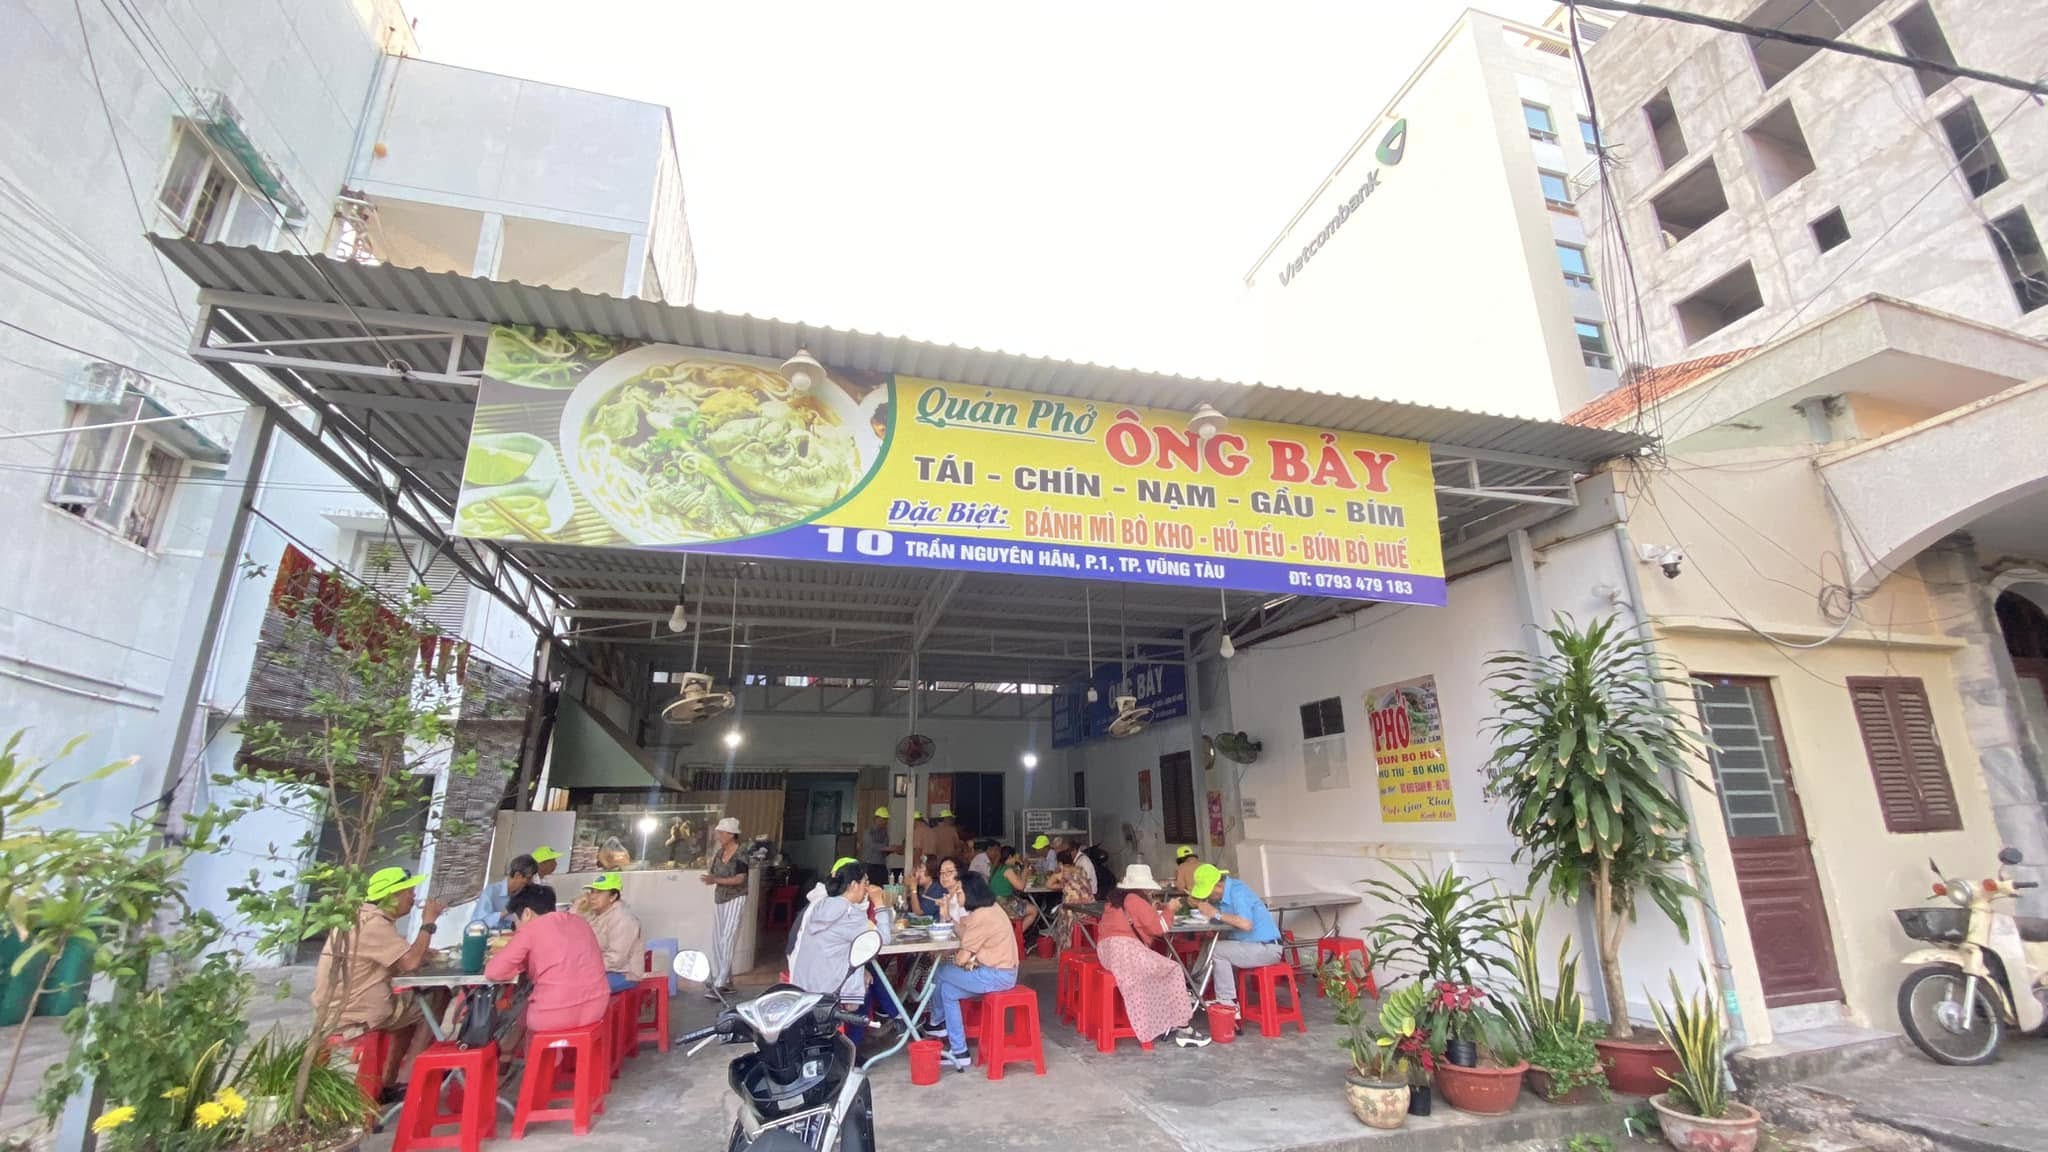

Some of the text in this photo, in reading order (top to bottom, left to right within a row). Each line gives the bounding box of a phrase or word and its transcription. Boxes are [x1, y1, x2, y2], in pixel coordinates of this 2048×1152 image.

[1278, 168, 1381, 287] Vietcombank
[915, 387, 1396, 493] Quán Phở ÔNG BẢY
[914, 454, 974, 485] TÁI
[1014, 467, 1101, 497] CHÍN
[1137, 479, 1216, 509] NẠM
[1346, 499, 1405, 527] BÍM
[818, 527, 1225, 579] 10 TRẦN NGUYÊN HÃN, P.1, TP. VŨNG TÀU
[888, 500, 942, 527] Đặc
[947, 503, 1009, 529] Biệt:
[1025, 507, 1083, 540] BÁNH
[1089, 512, 1115, 543] MÌ
[1121, 514, 1148, 546] BÒ
[1154, 521, 1193, 550] KHO
[1213, 520, 1239, 553] HỦ
[1244, 524, 1285, 557] TIẾU
[1302, 531, 1341, 562] BÚN
[1345, 535, 1370, 565] BÒ
[1374, 538, 1409, 569] HUẾ
[1289, 571, 1413, 595] ĐT: 0793 479 183
